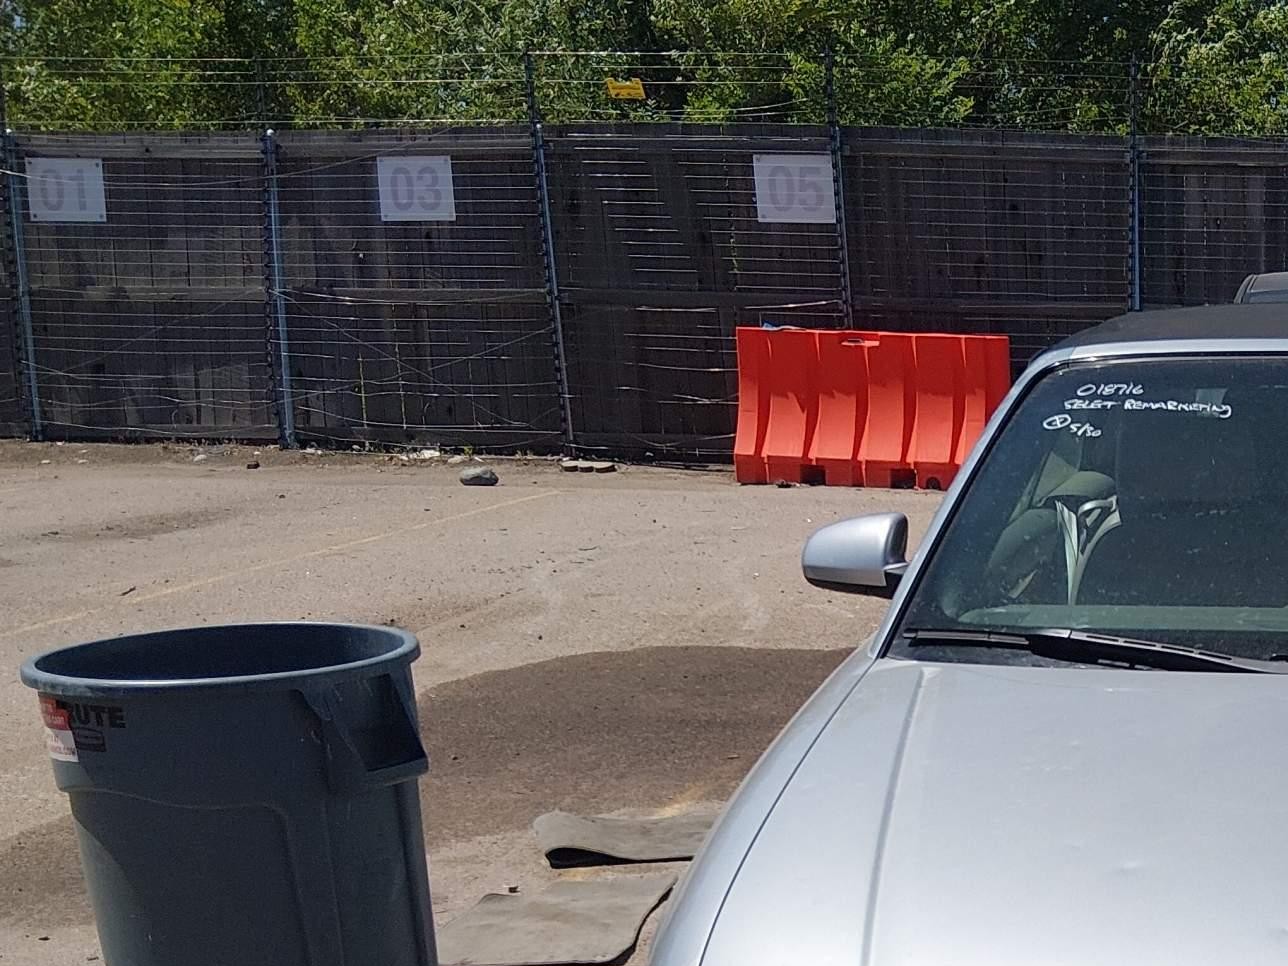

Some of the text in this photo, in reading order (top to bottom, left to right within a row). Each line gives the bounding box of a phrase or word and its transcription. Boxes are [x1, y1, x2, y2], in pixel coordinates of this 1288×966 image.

[40, 168, 87, 212] 01
[390, 166, 442, 211] 03
[767, 166, 825, 212] 05
